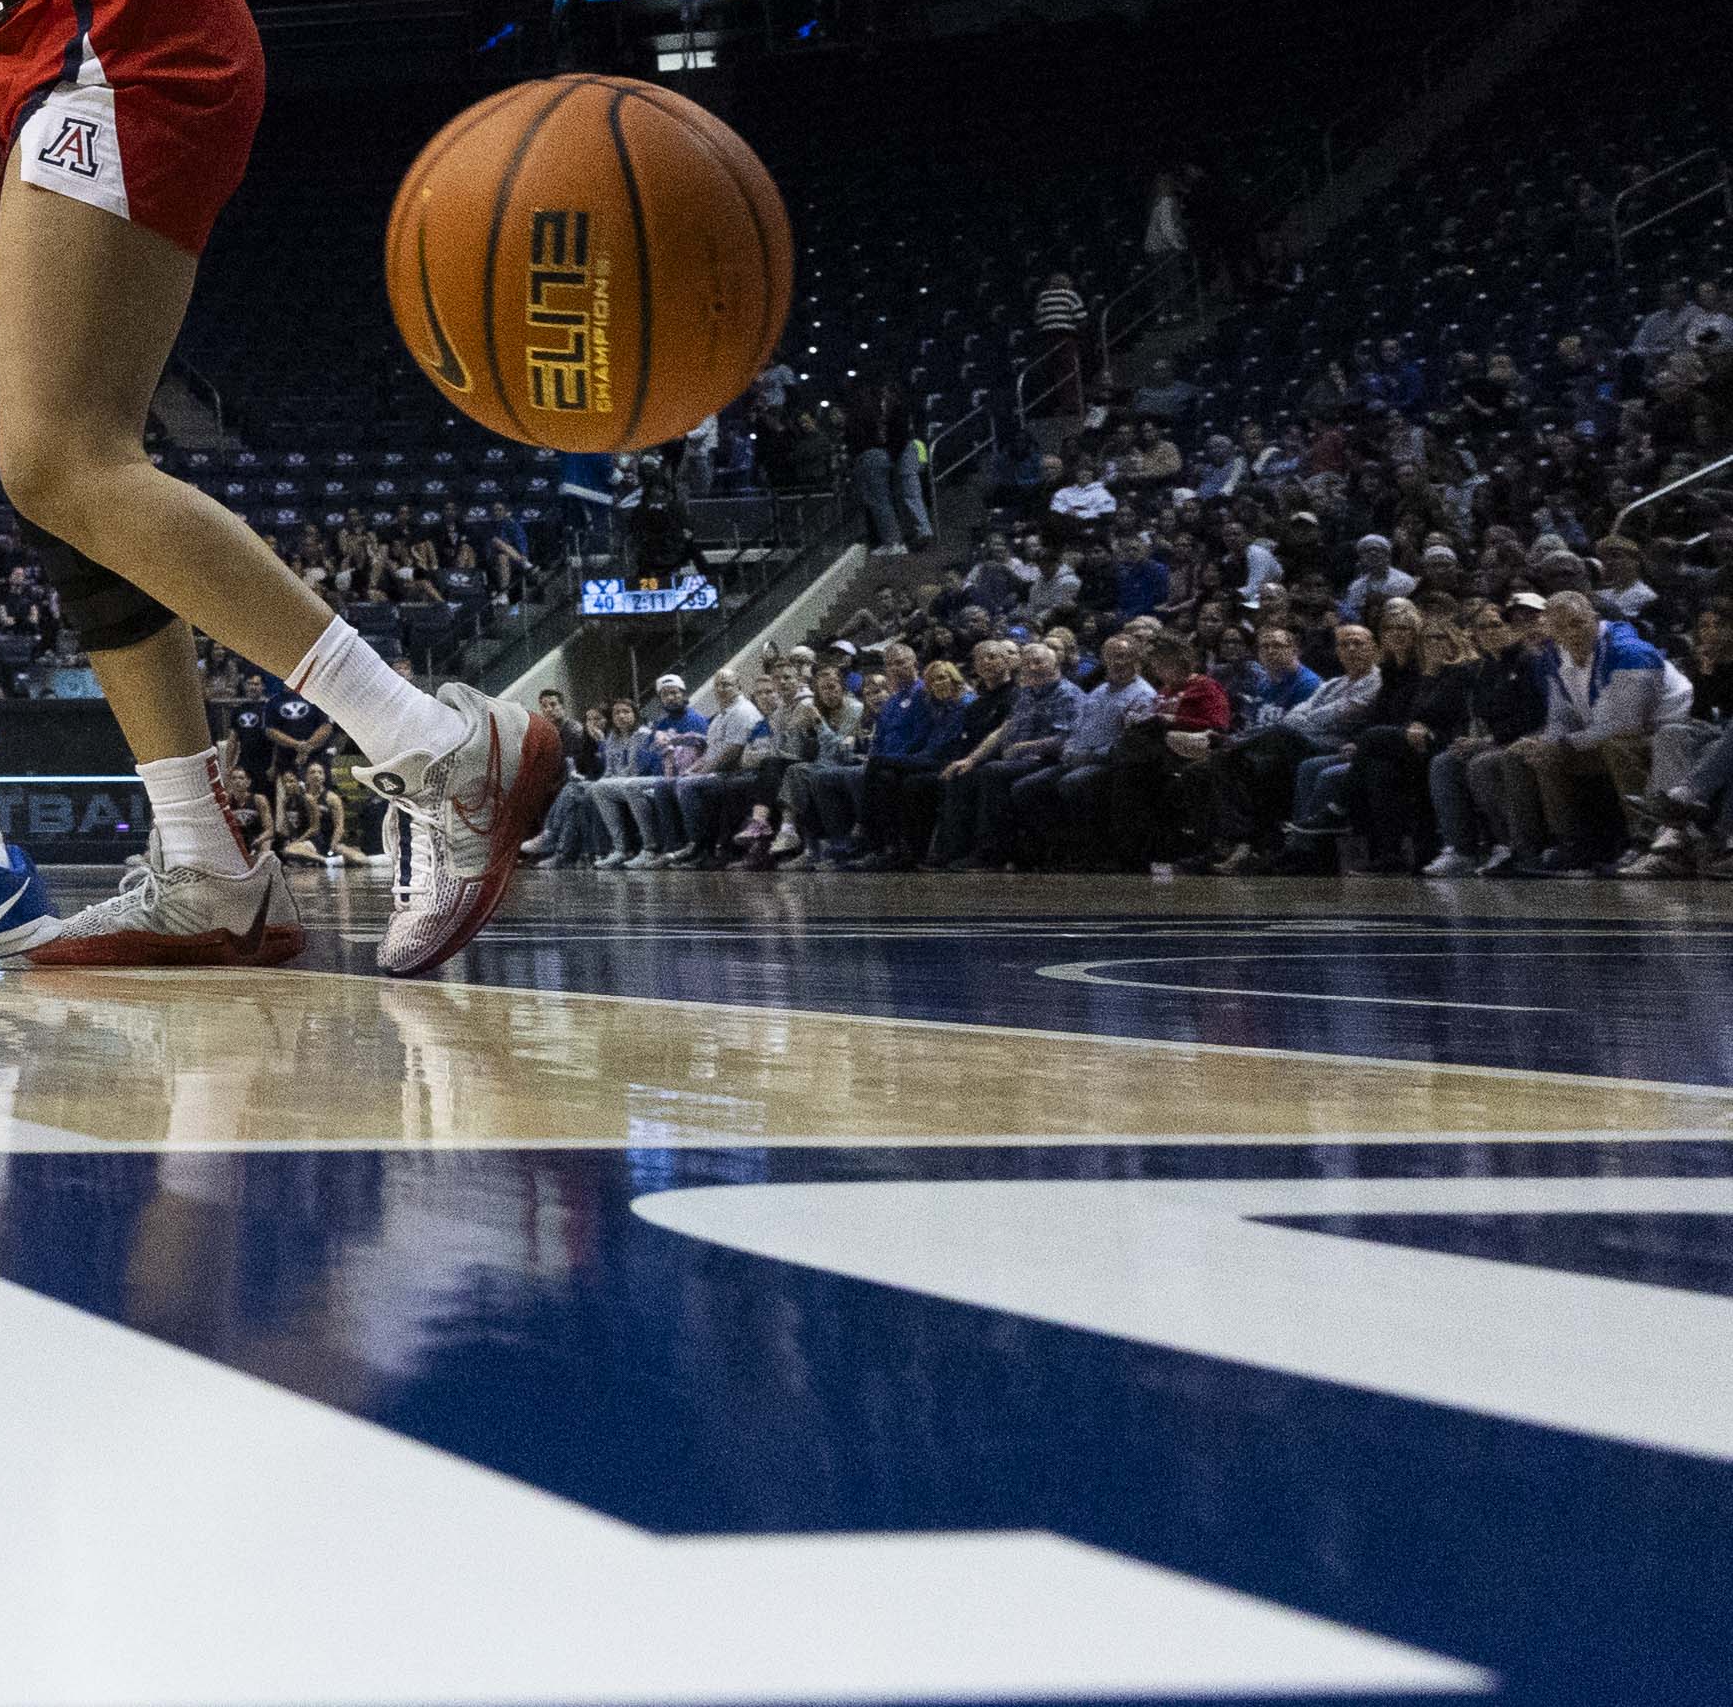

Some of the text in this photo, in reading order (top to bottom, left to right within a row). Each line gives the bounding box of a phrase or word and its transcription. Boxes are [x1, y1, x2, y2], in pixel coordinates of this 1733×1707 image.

[39, 115, 103, 179] A
[527, 209, 592, 414] ELITE
[594, 595, 615, 610] 40
